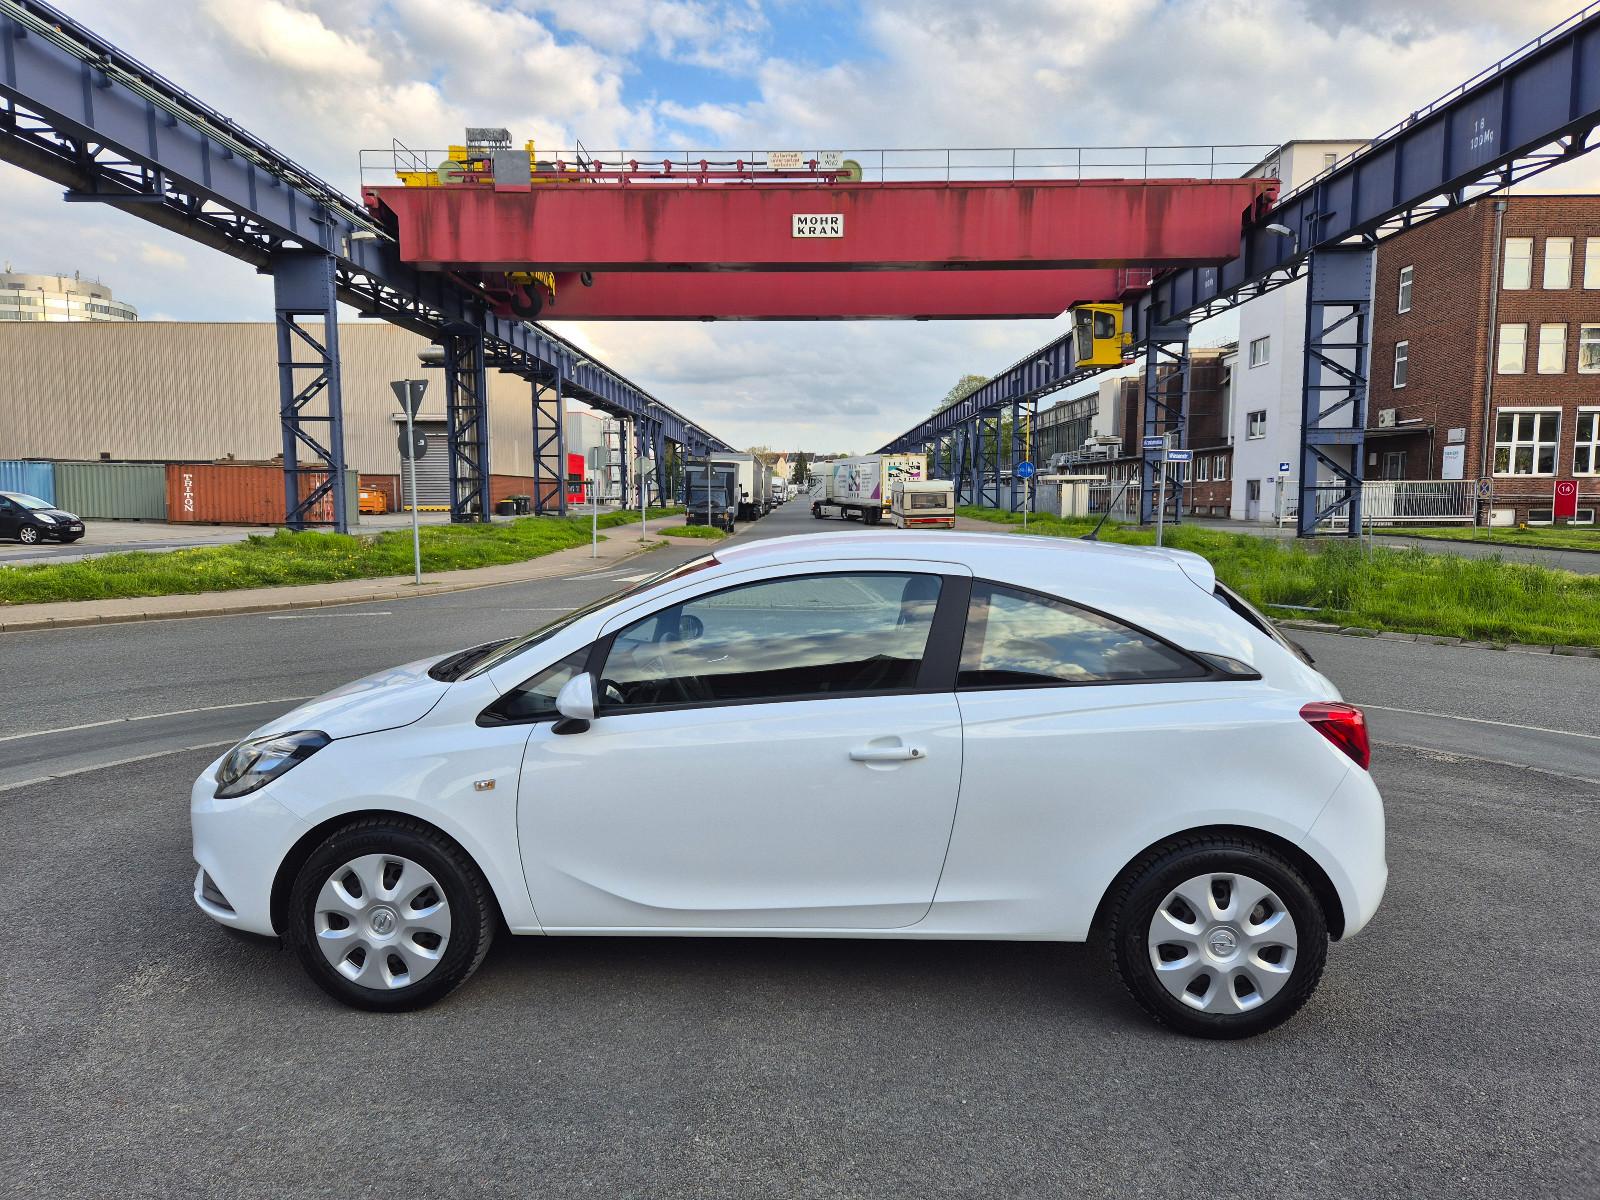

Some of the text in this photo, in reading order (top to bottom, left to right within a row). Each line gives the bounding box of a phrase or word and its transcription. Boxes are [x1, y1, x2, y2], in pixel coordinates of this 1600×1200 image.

[797, 216, 839, 225] MOHR
[797, 226, 839, 235] KRAN
[183, 473, 194, 512] TRITON
[1561, 485, 1571, 493] 14
